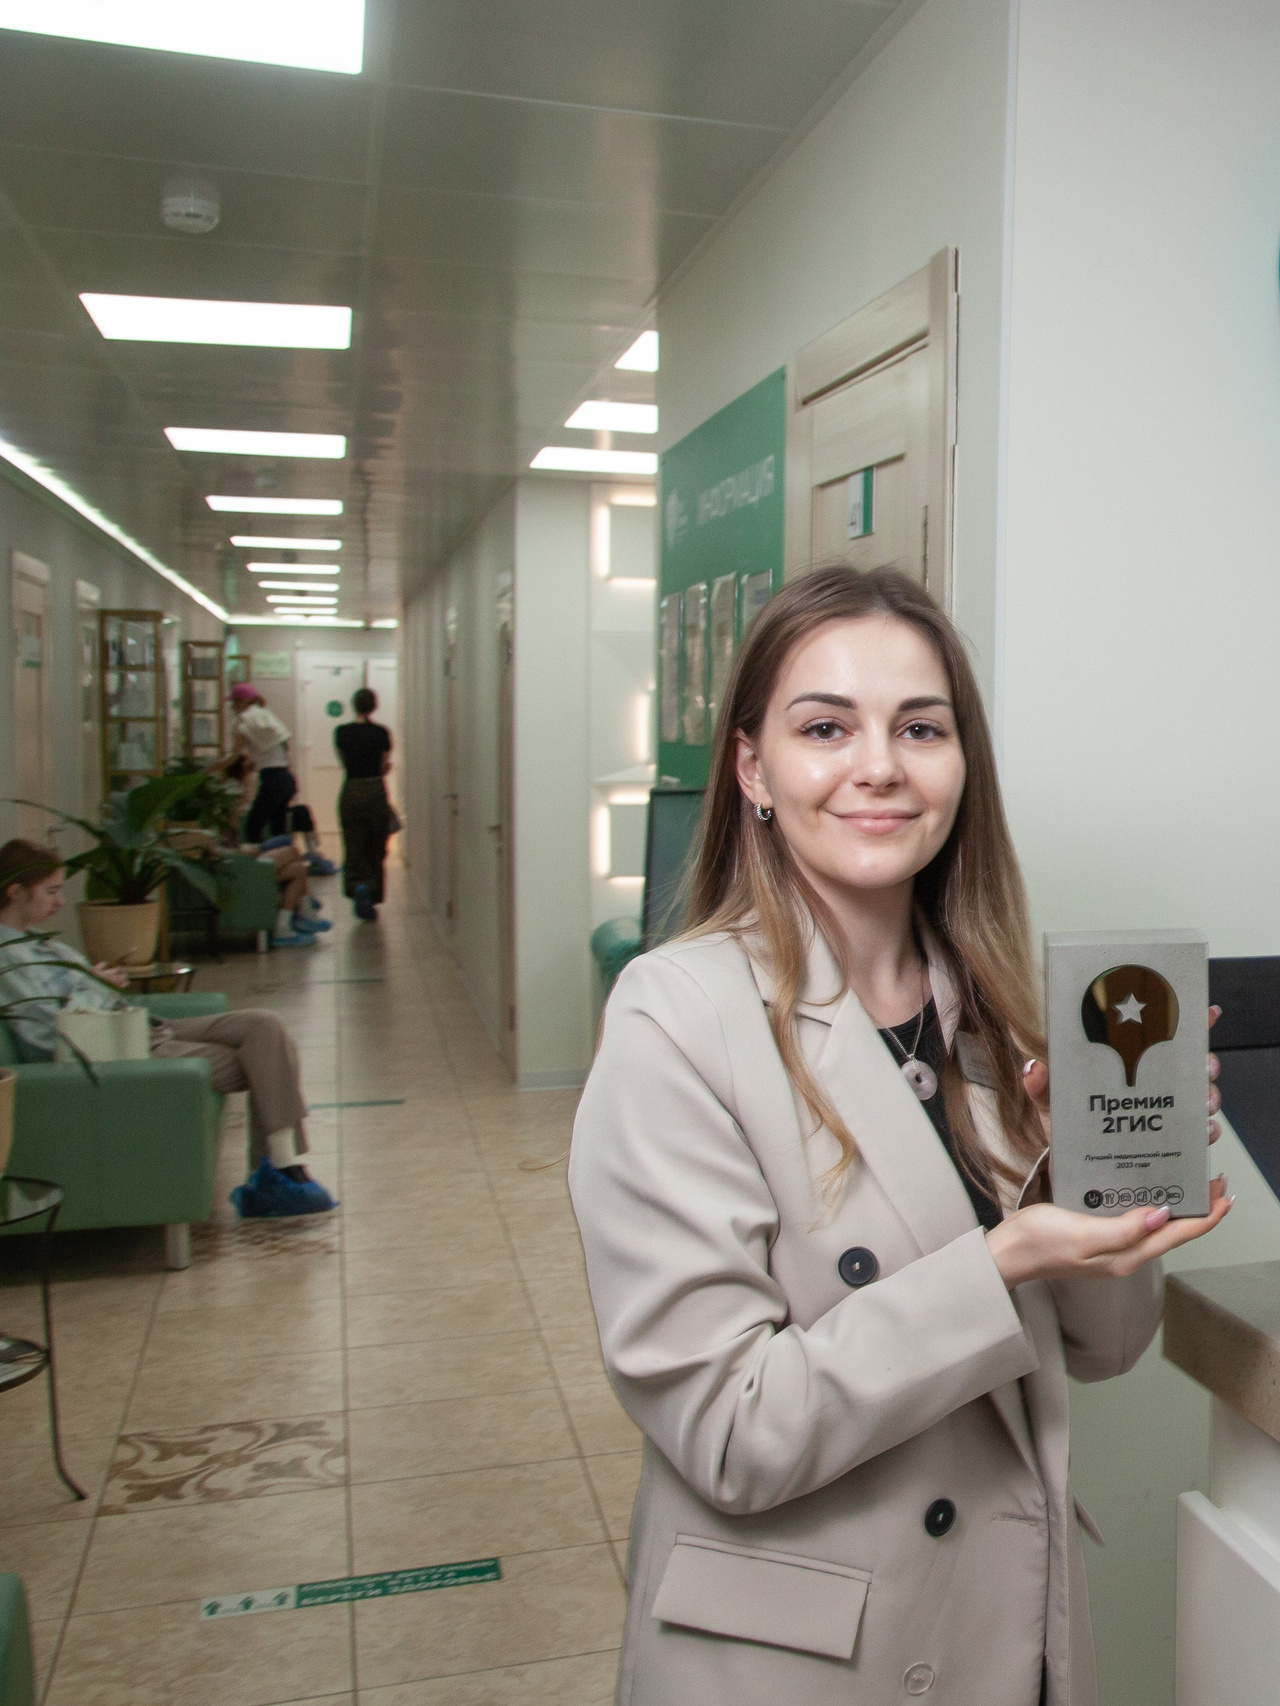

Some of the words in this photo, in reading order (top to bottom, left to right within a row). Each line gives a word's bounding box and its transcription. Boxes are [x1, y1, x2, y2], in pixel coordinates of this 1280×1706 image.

[1090, 1094, 1174, 1115] Премия
[1103, 1114, 1163, 1133] 2ГИС
[1085, 1153, 1113, 1162] Лучший
[1114, 1151, 1160, 1160] медицинский
